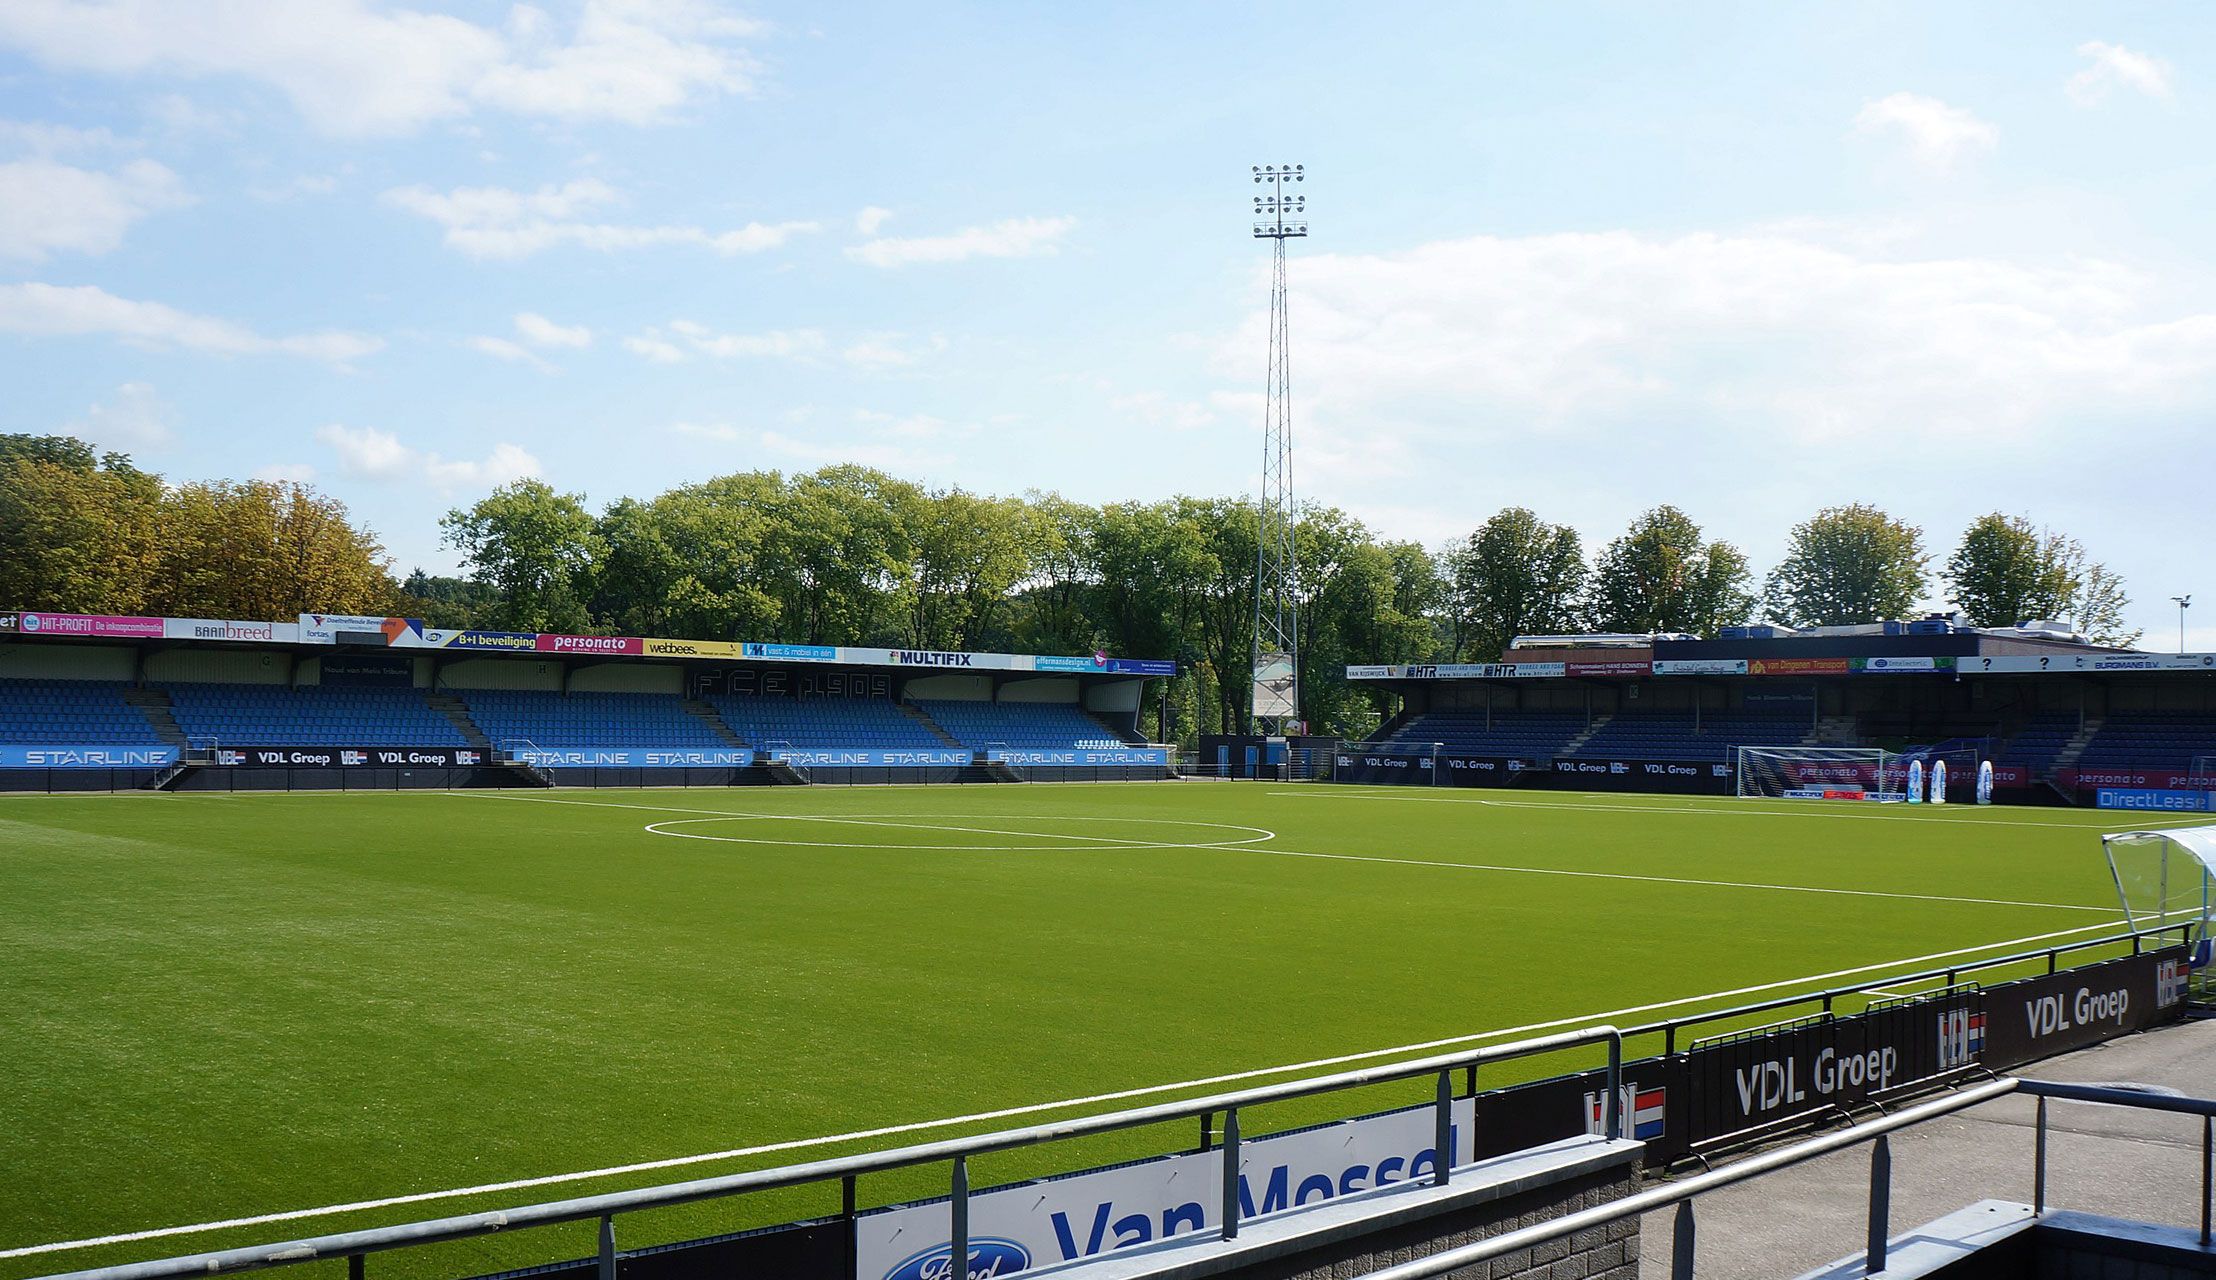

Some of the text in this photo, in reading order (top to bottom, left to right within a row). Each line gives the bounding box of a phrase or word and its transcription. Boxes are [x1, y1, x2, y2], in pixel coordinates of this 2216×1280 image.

[41, 617, 93, 631] HIT-PROFIT
[478, 634, 537, 650] beveiliging
[553, 636, 626, 651] personato
[900, 651, 972, 667] MULTIFIX
[1982, 657, 1992, 671] ?
[2040, 657, 2049, 670] ?
[1416, 665, 1438, 678] HTR
[1494, 664, 1516, 677] HTR
[26, 750, 168, 765] STARLINE
[257, 751, 288, 764] VDL
[290, 751, 331, 767] Groep
[378, 751, 407, 764] VDL
[408, 751, 446, 767] Groep
[522, 752, 746, 765] STARLINE STARLINE
[779, 752, 968, 765] STARLINE STARLINE
[999, 752, 1157, 764] STARLINE STARLINE
[1364, 757, 1383, 767] VDL
[1383, 758, 1408, 768] Groep
[1448, 759, 1468, 770] VDL
[1469, 760, 1495, 771] Groep
[1556, 762, 1577, 772] VDL
[1578, 763, 1607, 774] Groep
[1643, 763, 1666, 774] VDL
[1667, 764, 1697, 776] Groep
[2099, 790, 2207, 809] DirectLease
[2026, 993, 2069, 1039] VDL
[2074, 987, 2129, 1026] Groep
[1736, 1055, 1805, 1116] VDL
[1813, 1044, 1898, 1096] Groep
[1051, 1200, 1206, 1262] Van
[919, 1249, 1002, 1280] Frd
